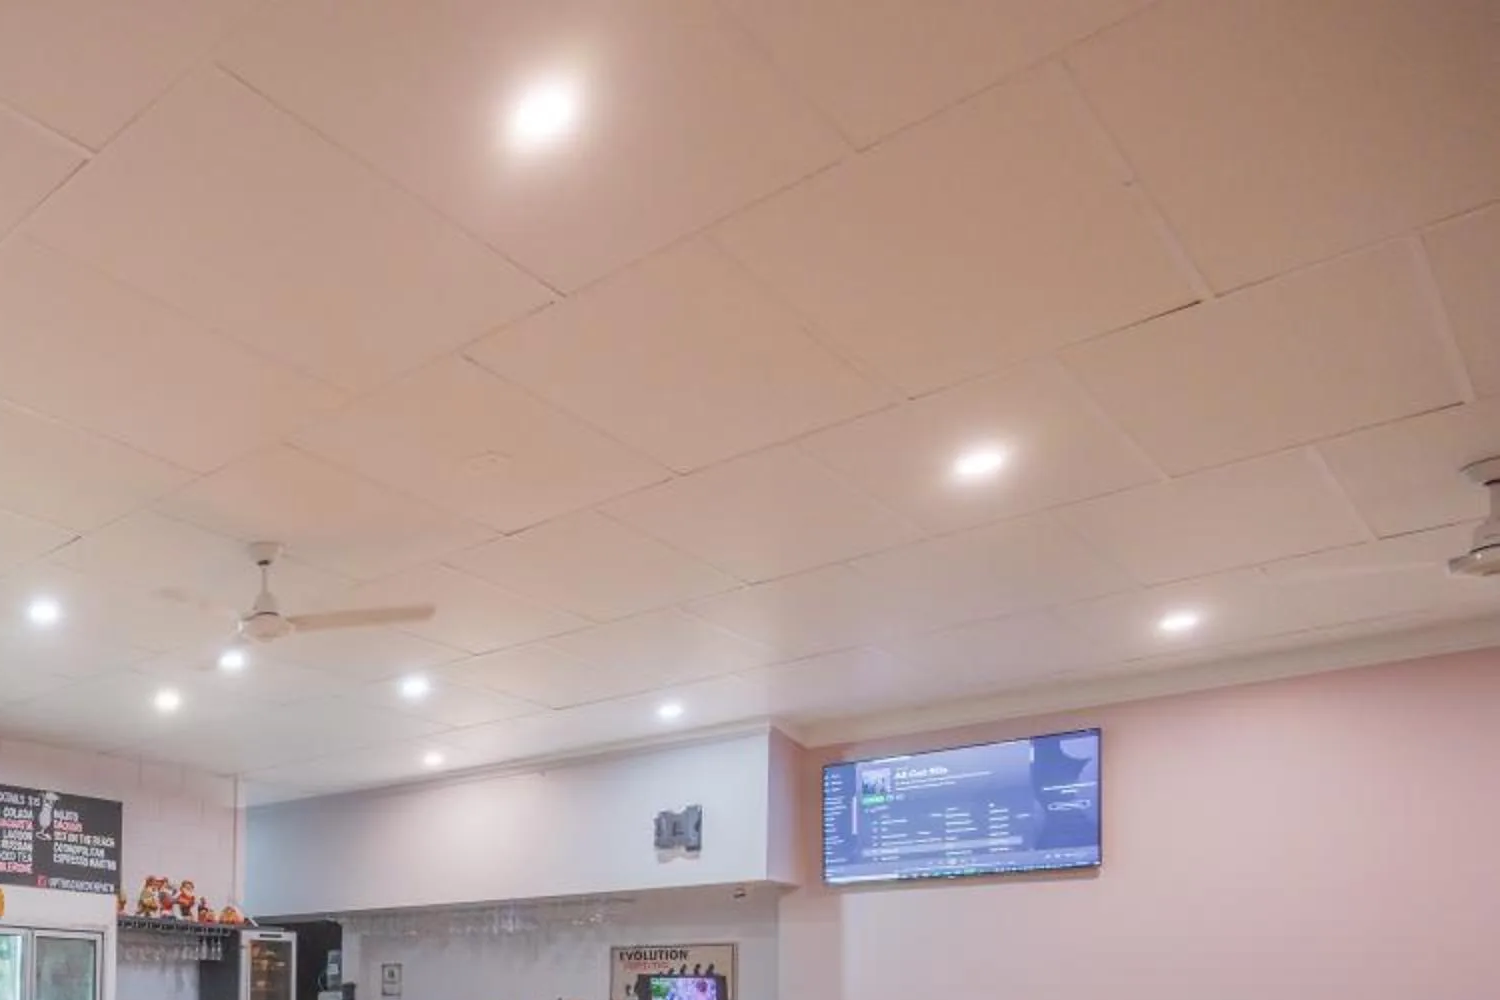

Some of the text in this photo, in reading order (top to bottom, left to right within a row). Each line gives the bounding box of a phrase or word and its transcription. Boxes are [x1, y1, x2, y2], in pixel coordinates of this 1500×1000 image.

[3, 806, 33, 819] COLADA
[3, 828, 33, 841] LAGOON
[619, 949, 688, 961] EVOLUTION
